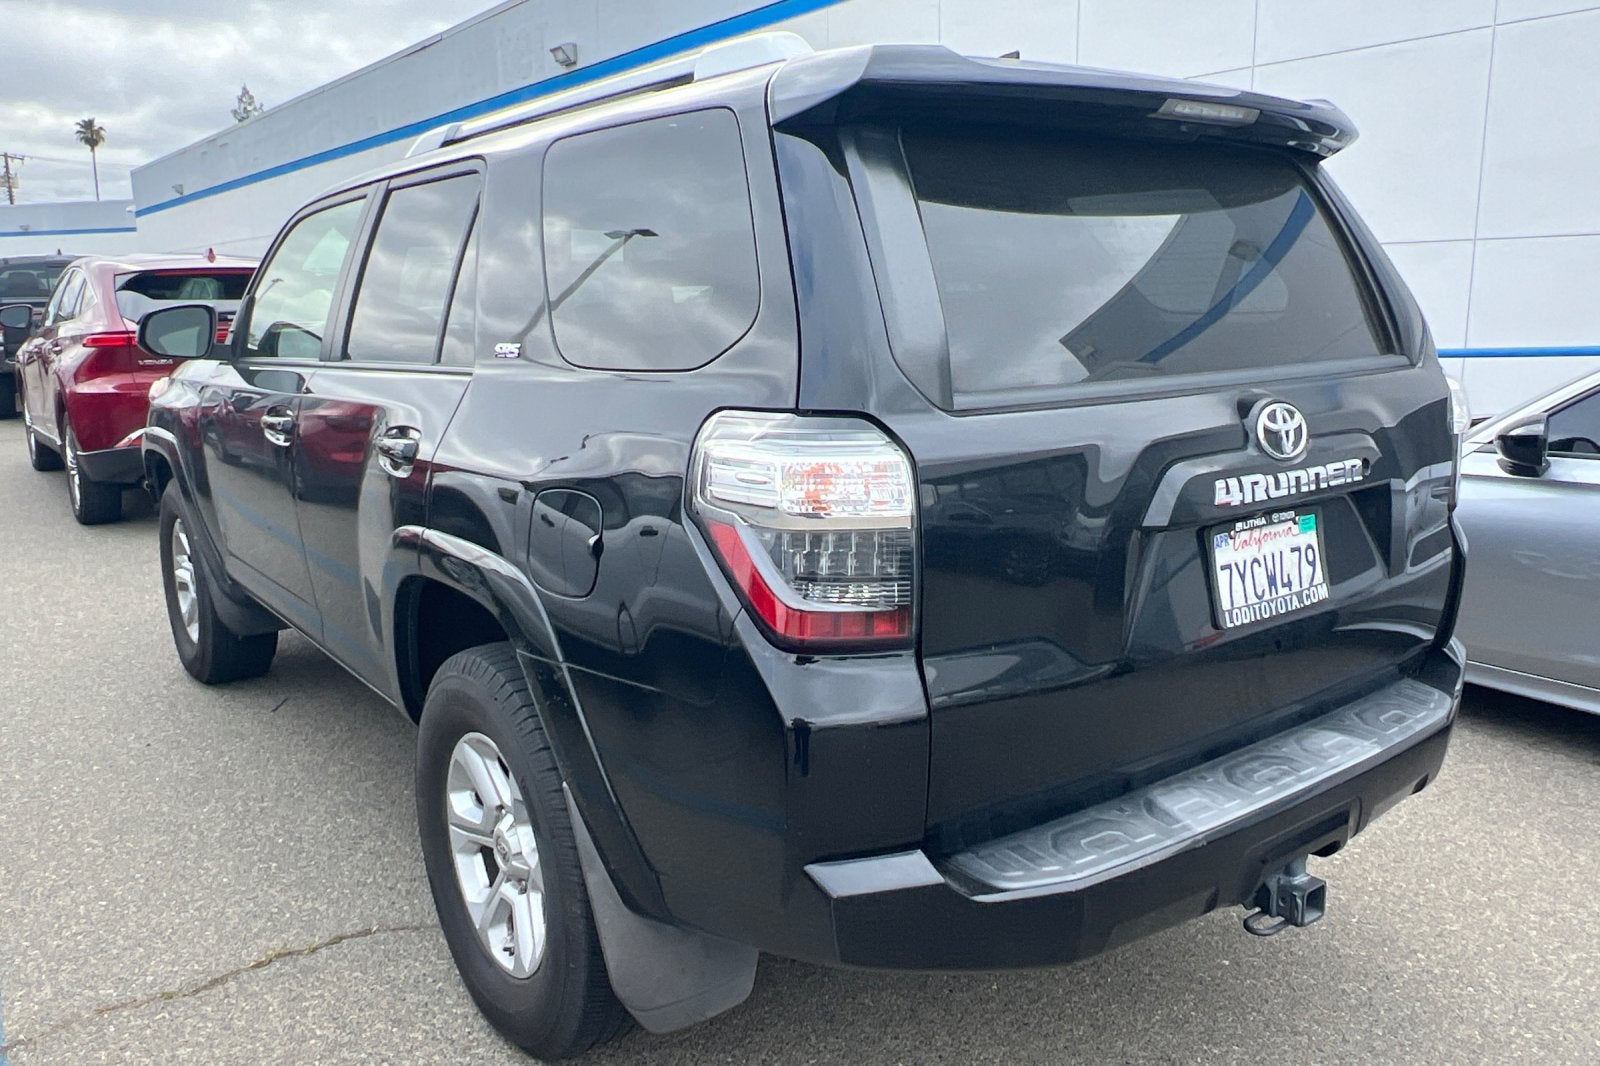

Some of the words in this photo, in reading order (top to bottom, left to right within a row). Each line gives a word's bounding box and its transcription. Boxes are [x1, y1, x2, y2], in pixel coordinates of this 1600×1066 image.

[1243, 516, 1267, 529] LITHIA
[1233, 524, 1300, 553] California
[1219, 543, 1317, 608] 7YCW479
